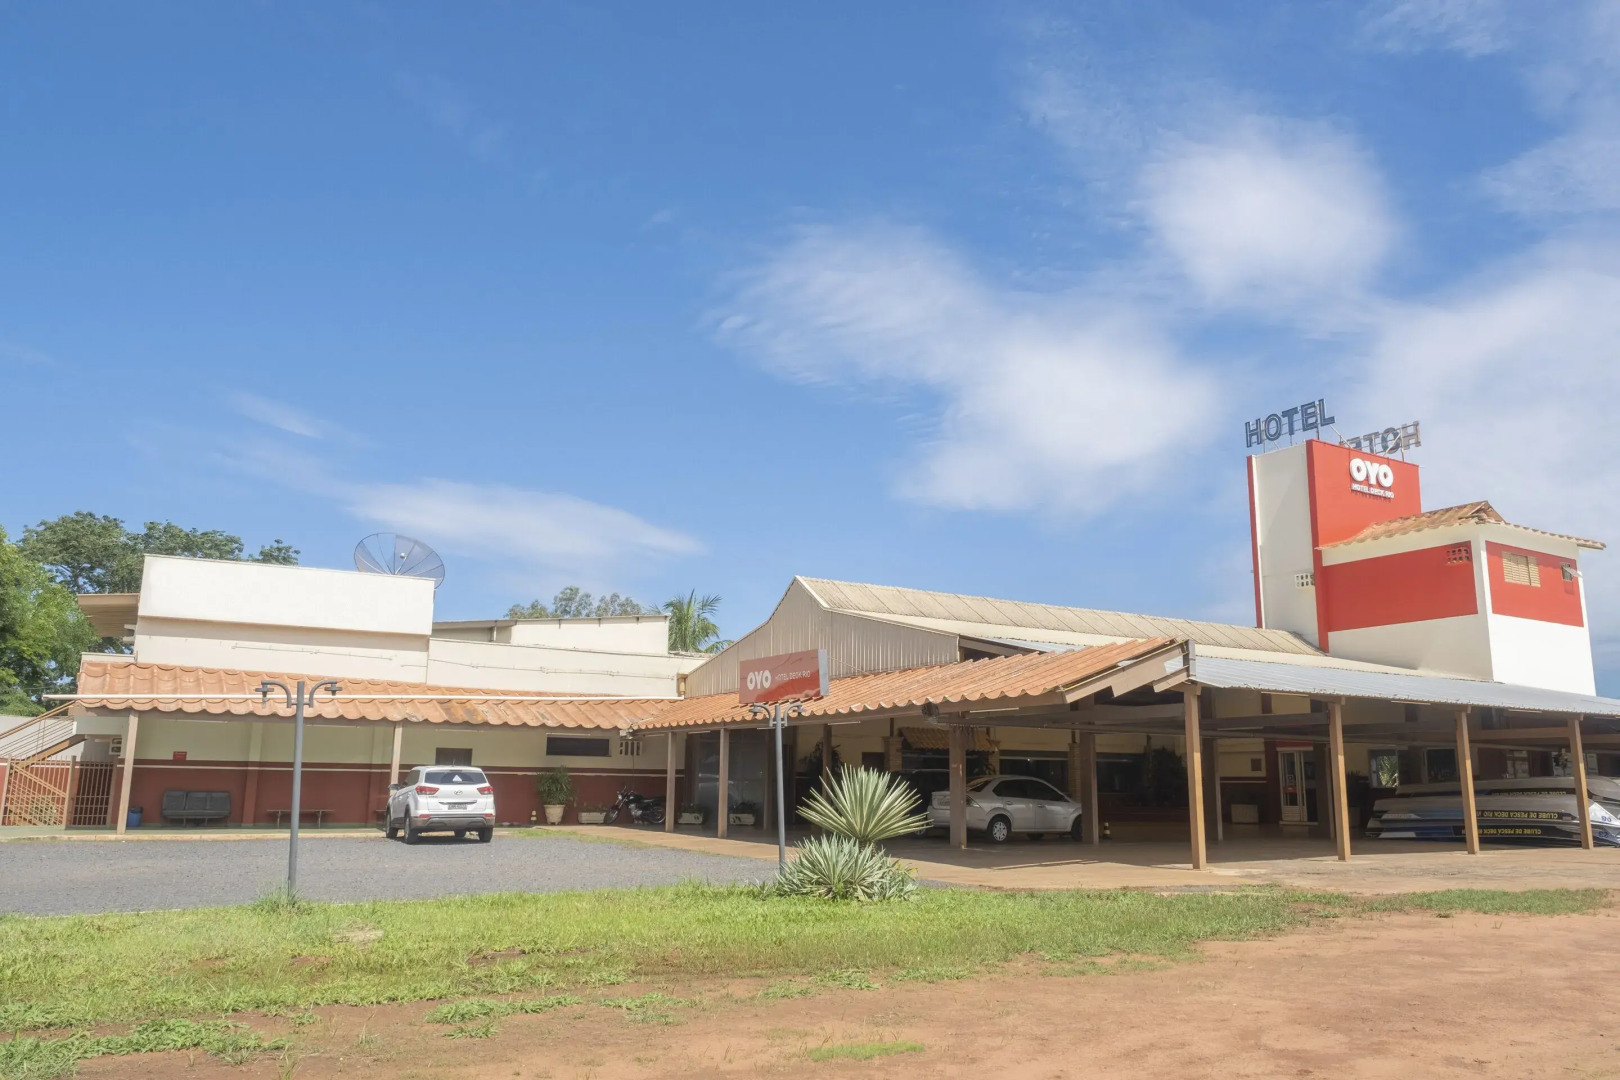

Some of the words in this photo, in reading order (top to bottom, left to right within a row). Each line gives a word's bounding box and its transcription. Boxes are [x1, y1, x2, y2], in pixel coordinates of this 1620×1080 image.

[1245, 398, 1335, 448] HOTEL
[1350, 457, 1394, 488] OYO
[1351, 483, 1369, 492] HOTEL
[747, 669, 772, 691] OYO
[1510, 811, 1528, 819] PESCA
